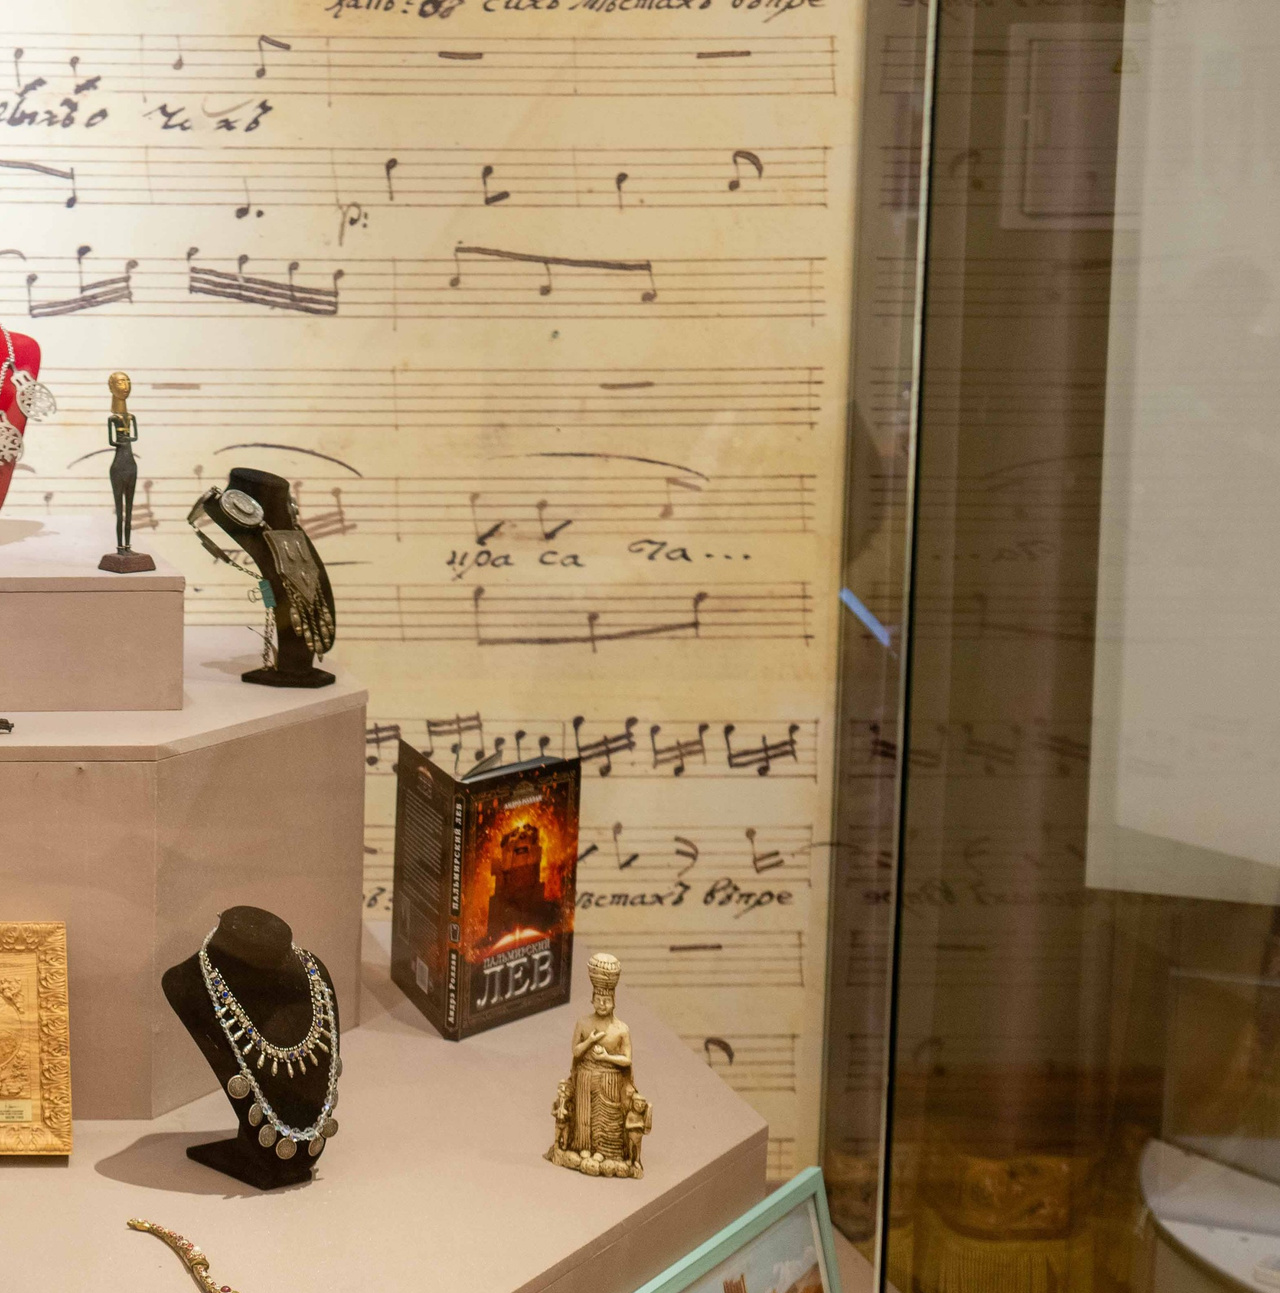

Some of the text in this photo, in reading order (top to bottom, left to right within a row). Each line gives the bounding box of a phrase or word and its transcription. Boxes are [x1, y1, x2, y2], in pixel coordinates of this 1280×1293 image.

[452, 803, 463, 910] ПАЛЬМИРСКИЙ ЛЕВ
[476, 950, 553, 1007] ЛЕВ
[483, 937, 551, 968] ПАЛЬМИРСКИЙ
